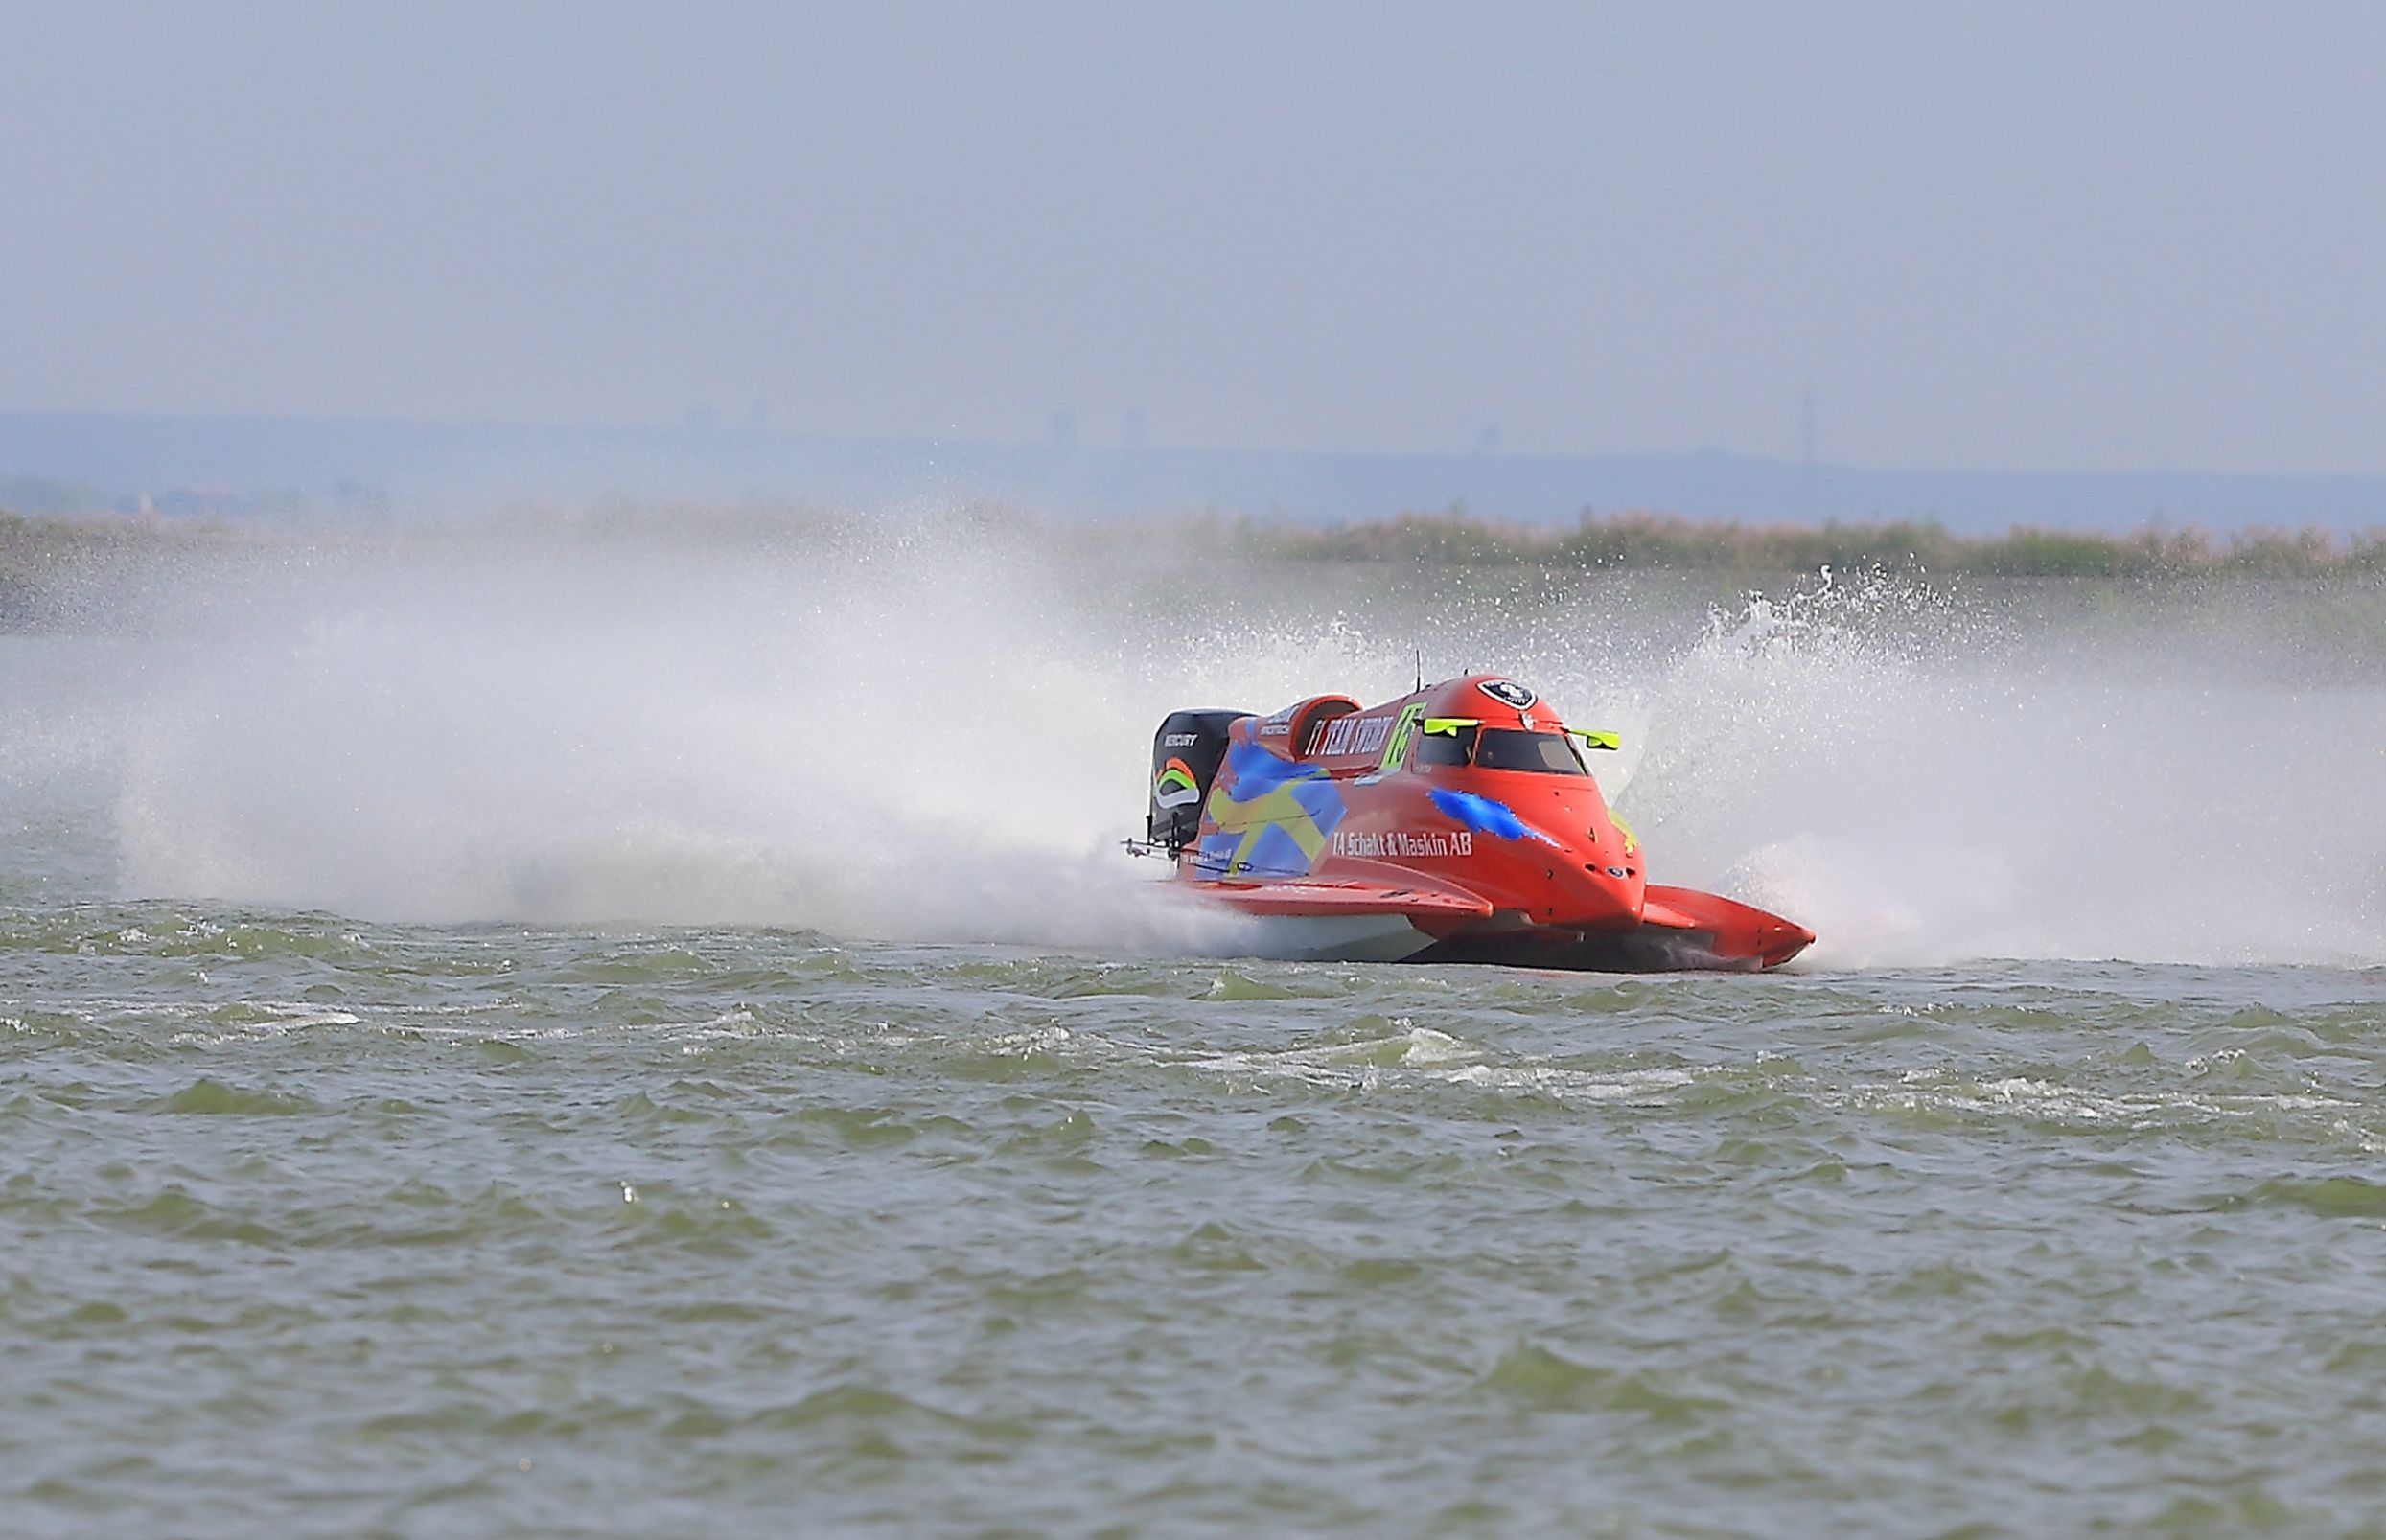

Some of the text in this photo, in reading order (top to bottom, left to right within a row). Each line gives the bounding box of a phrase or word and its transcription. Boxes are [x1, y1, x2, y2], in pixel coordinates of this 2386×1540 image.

[1347, 832, 1386, 856] Schakt
[1387, 832, 1398, 856] &
[1398, 832, 1448, 856] Maskin
[1449, 832, 1471, 856] AB
